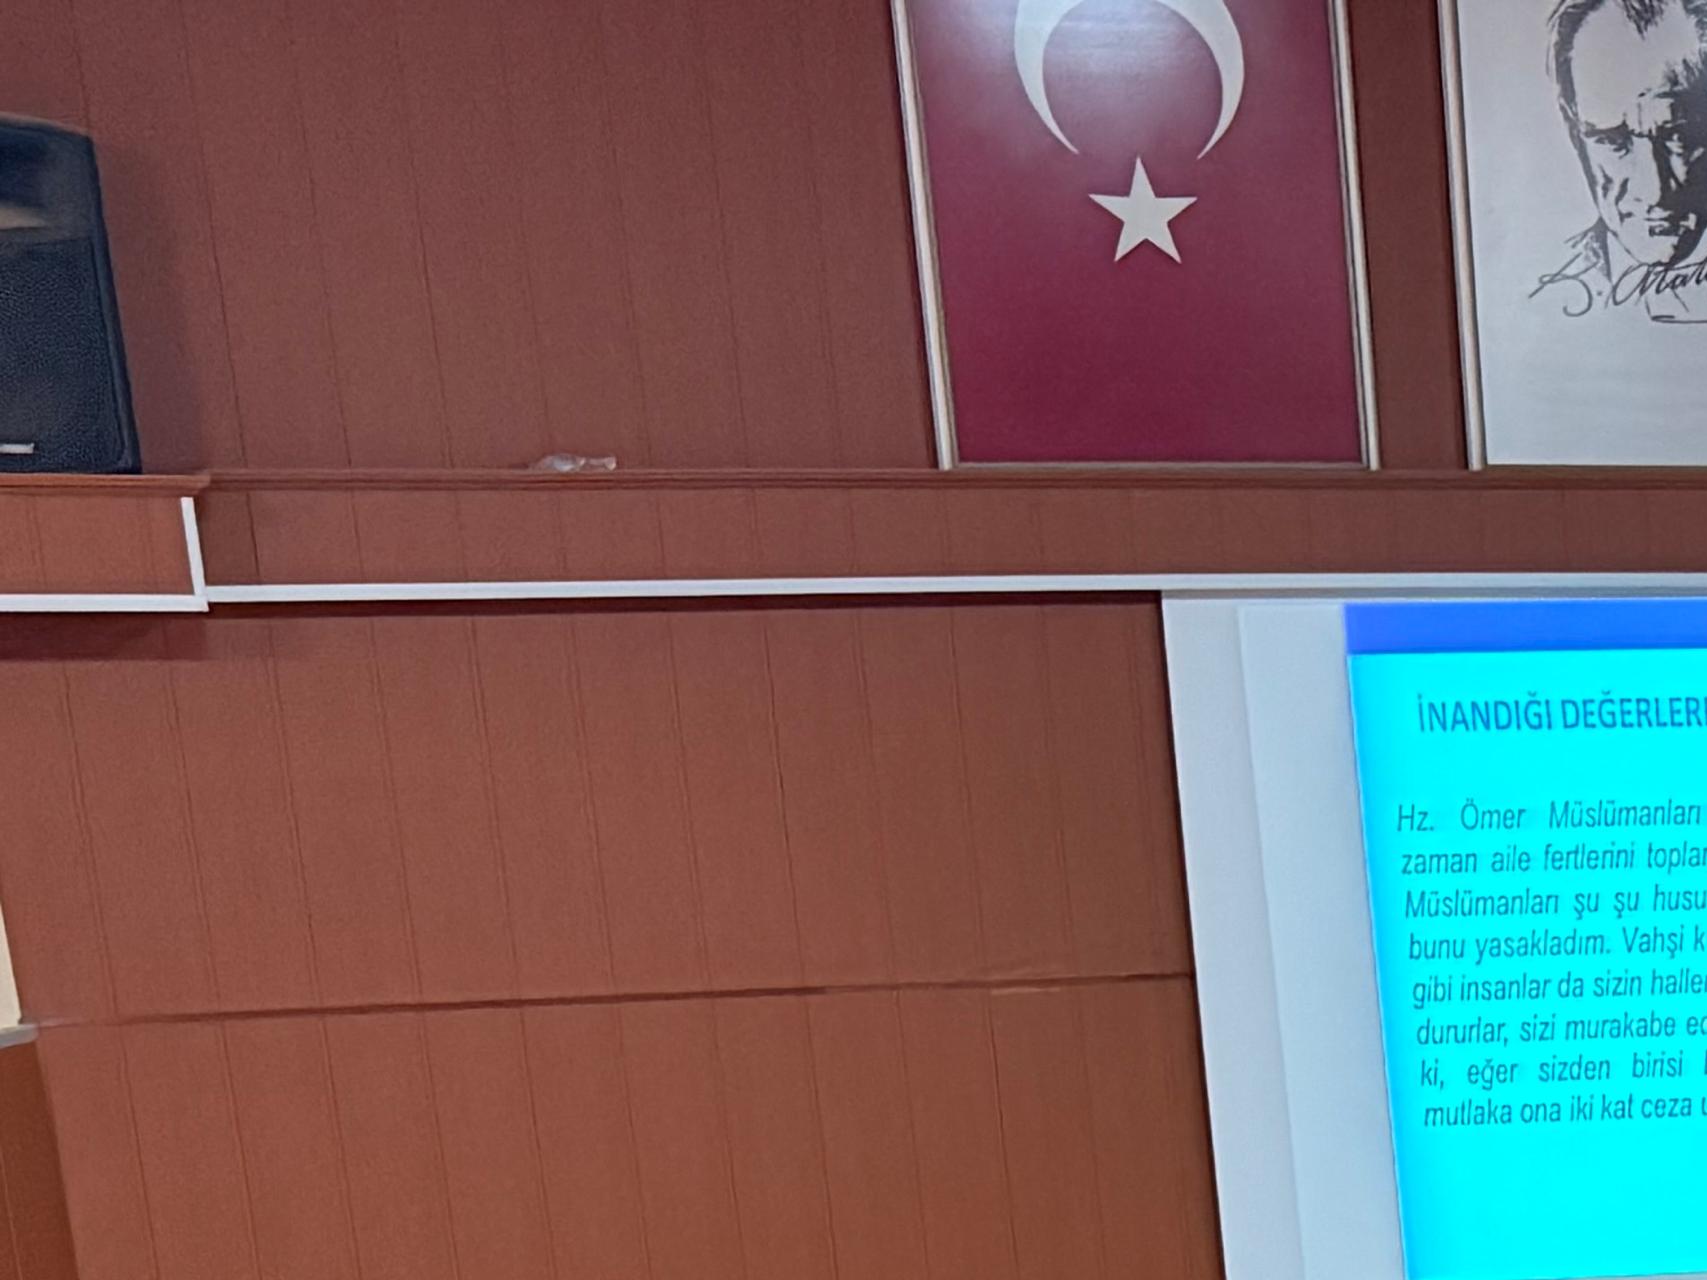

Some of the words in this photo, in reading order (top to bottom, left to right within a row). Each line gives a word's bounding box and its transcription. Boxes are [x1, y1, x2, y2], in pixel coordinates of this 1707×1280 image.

[1417, 690, 1553, 733] İNANDIĞI
[1397, 804, 1435, 832] Hz.
[1460, 798, 1527, 831] Ömer
[1549, 799, 1701, 829] Müslümanları
[1401, 852, 1477, 875] zaman
[1491, 845, 1531, 872] aile
[1543, 841, 1635, 871] fertlerini
[1405, 887, 1560, 919] Müslümanları
[1573, 891, 1600, 921] şu
[1613, 890, 1639, 920] şu
[1409, 932, 1466, 960] bunu
[1475, 927, 1612, 966] yasakladım.
[1622, 924, 1685, 959] Vahşi
[1412, 975, 1452, 1009] gibi
[1460, 972, 1552, 1001] insanlar
[1557, 970, 1584, 999] da
[1592, 969, 1642, 997] sizin
[1416, 1016, 1508, 1047] dururlar,
[1519, 1013, 1556, 1041] sizi
[1565, 1010, 1676, 1041] murakabe
[1420, 1058, 1445, 1090] ki,
[1467, 1058, 1519, 1091] eğer
[1538, 1054, 1611, 1082] sizden
[1632, 1050, 1684, 1078] birisi
[1424, 1099, 1513, 1127] mutlaka
[1520, 1102, 1561, 1123] ona
[1570, 1094, 1595, 1122] iki
[1601, 1093, 1634, 1120] kat
[1641, 1097, 1693, 1120] ceza
